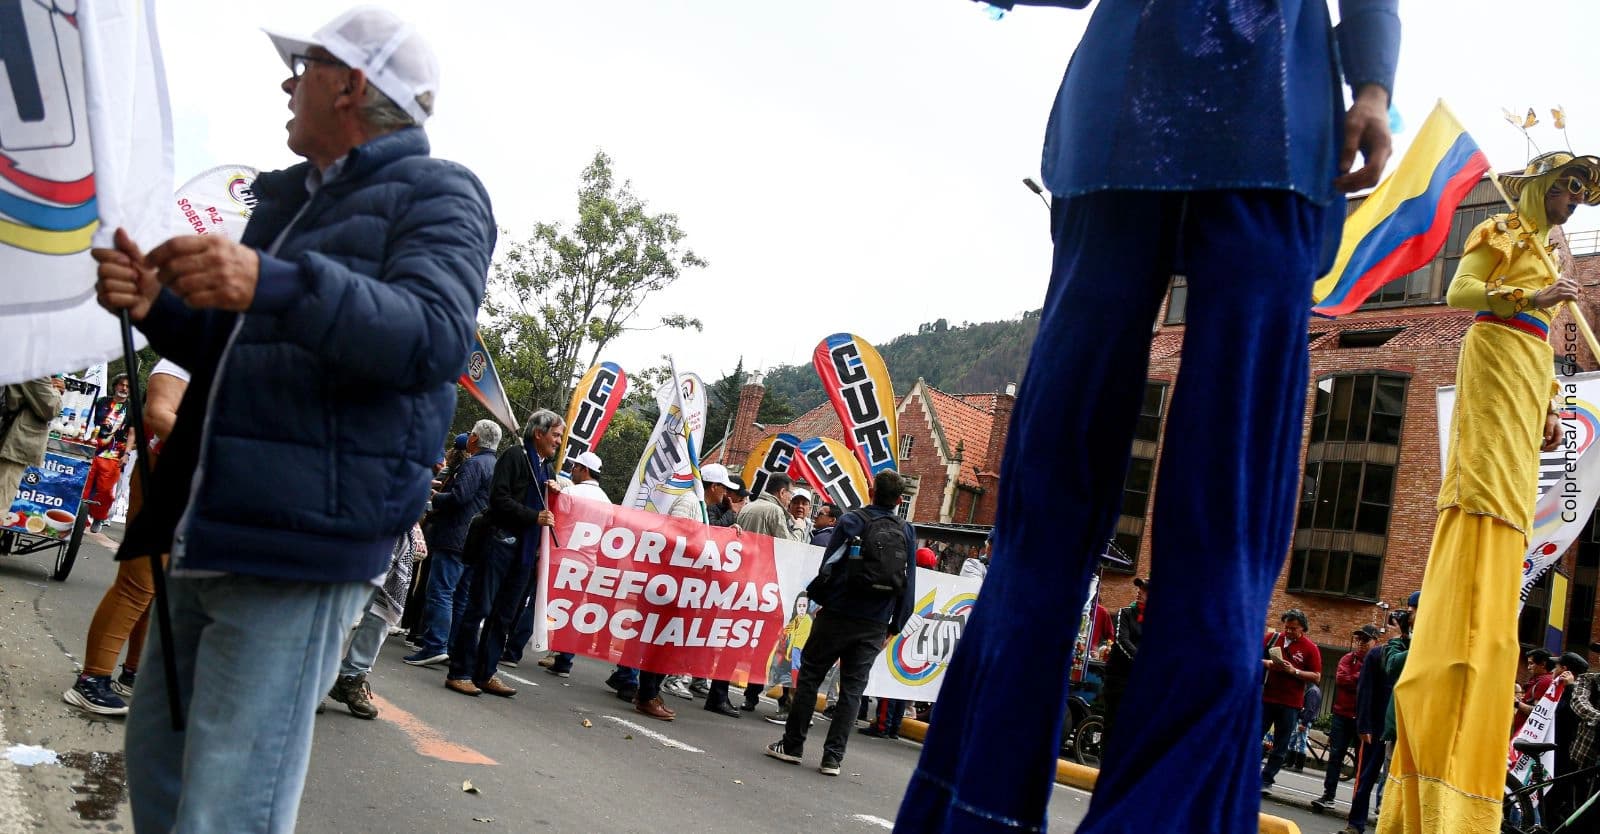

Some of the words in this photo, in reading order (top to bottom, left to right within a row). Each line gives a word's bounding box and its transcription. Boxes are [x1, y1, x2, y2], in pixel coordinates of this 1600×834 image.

[205, 206, 224, 225] PAZ
[562, 368, 617, 474] CUT
[830, 342, 890, 465] CUT
[567, 521, 668, 564] POR
[669, 536, 743, 573] LAS
[553, 558, 779, 613] REFORMAS
[547, 598, 765, 648] SOCIALES!
